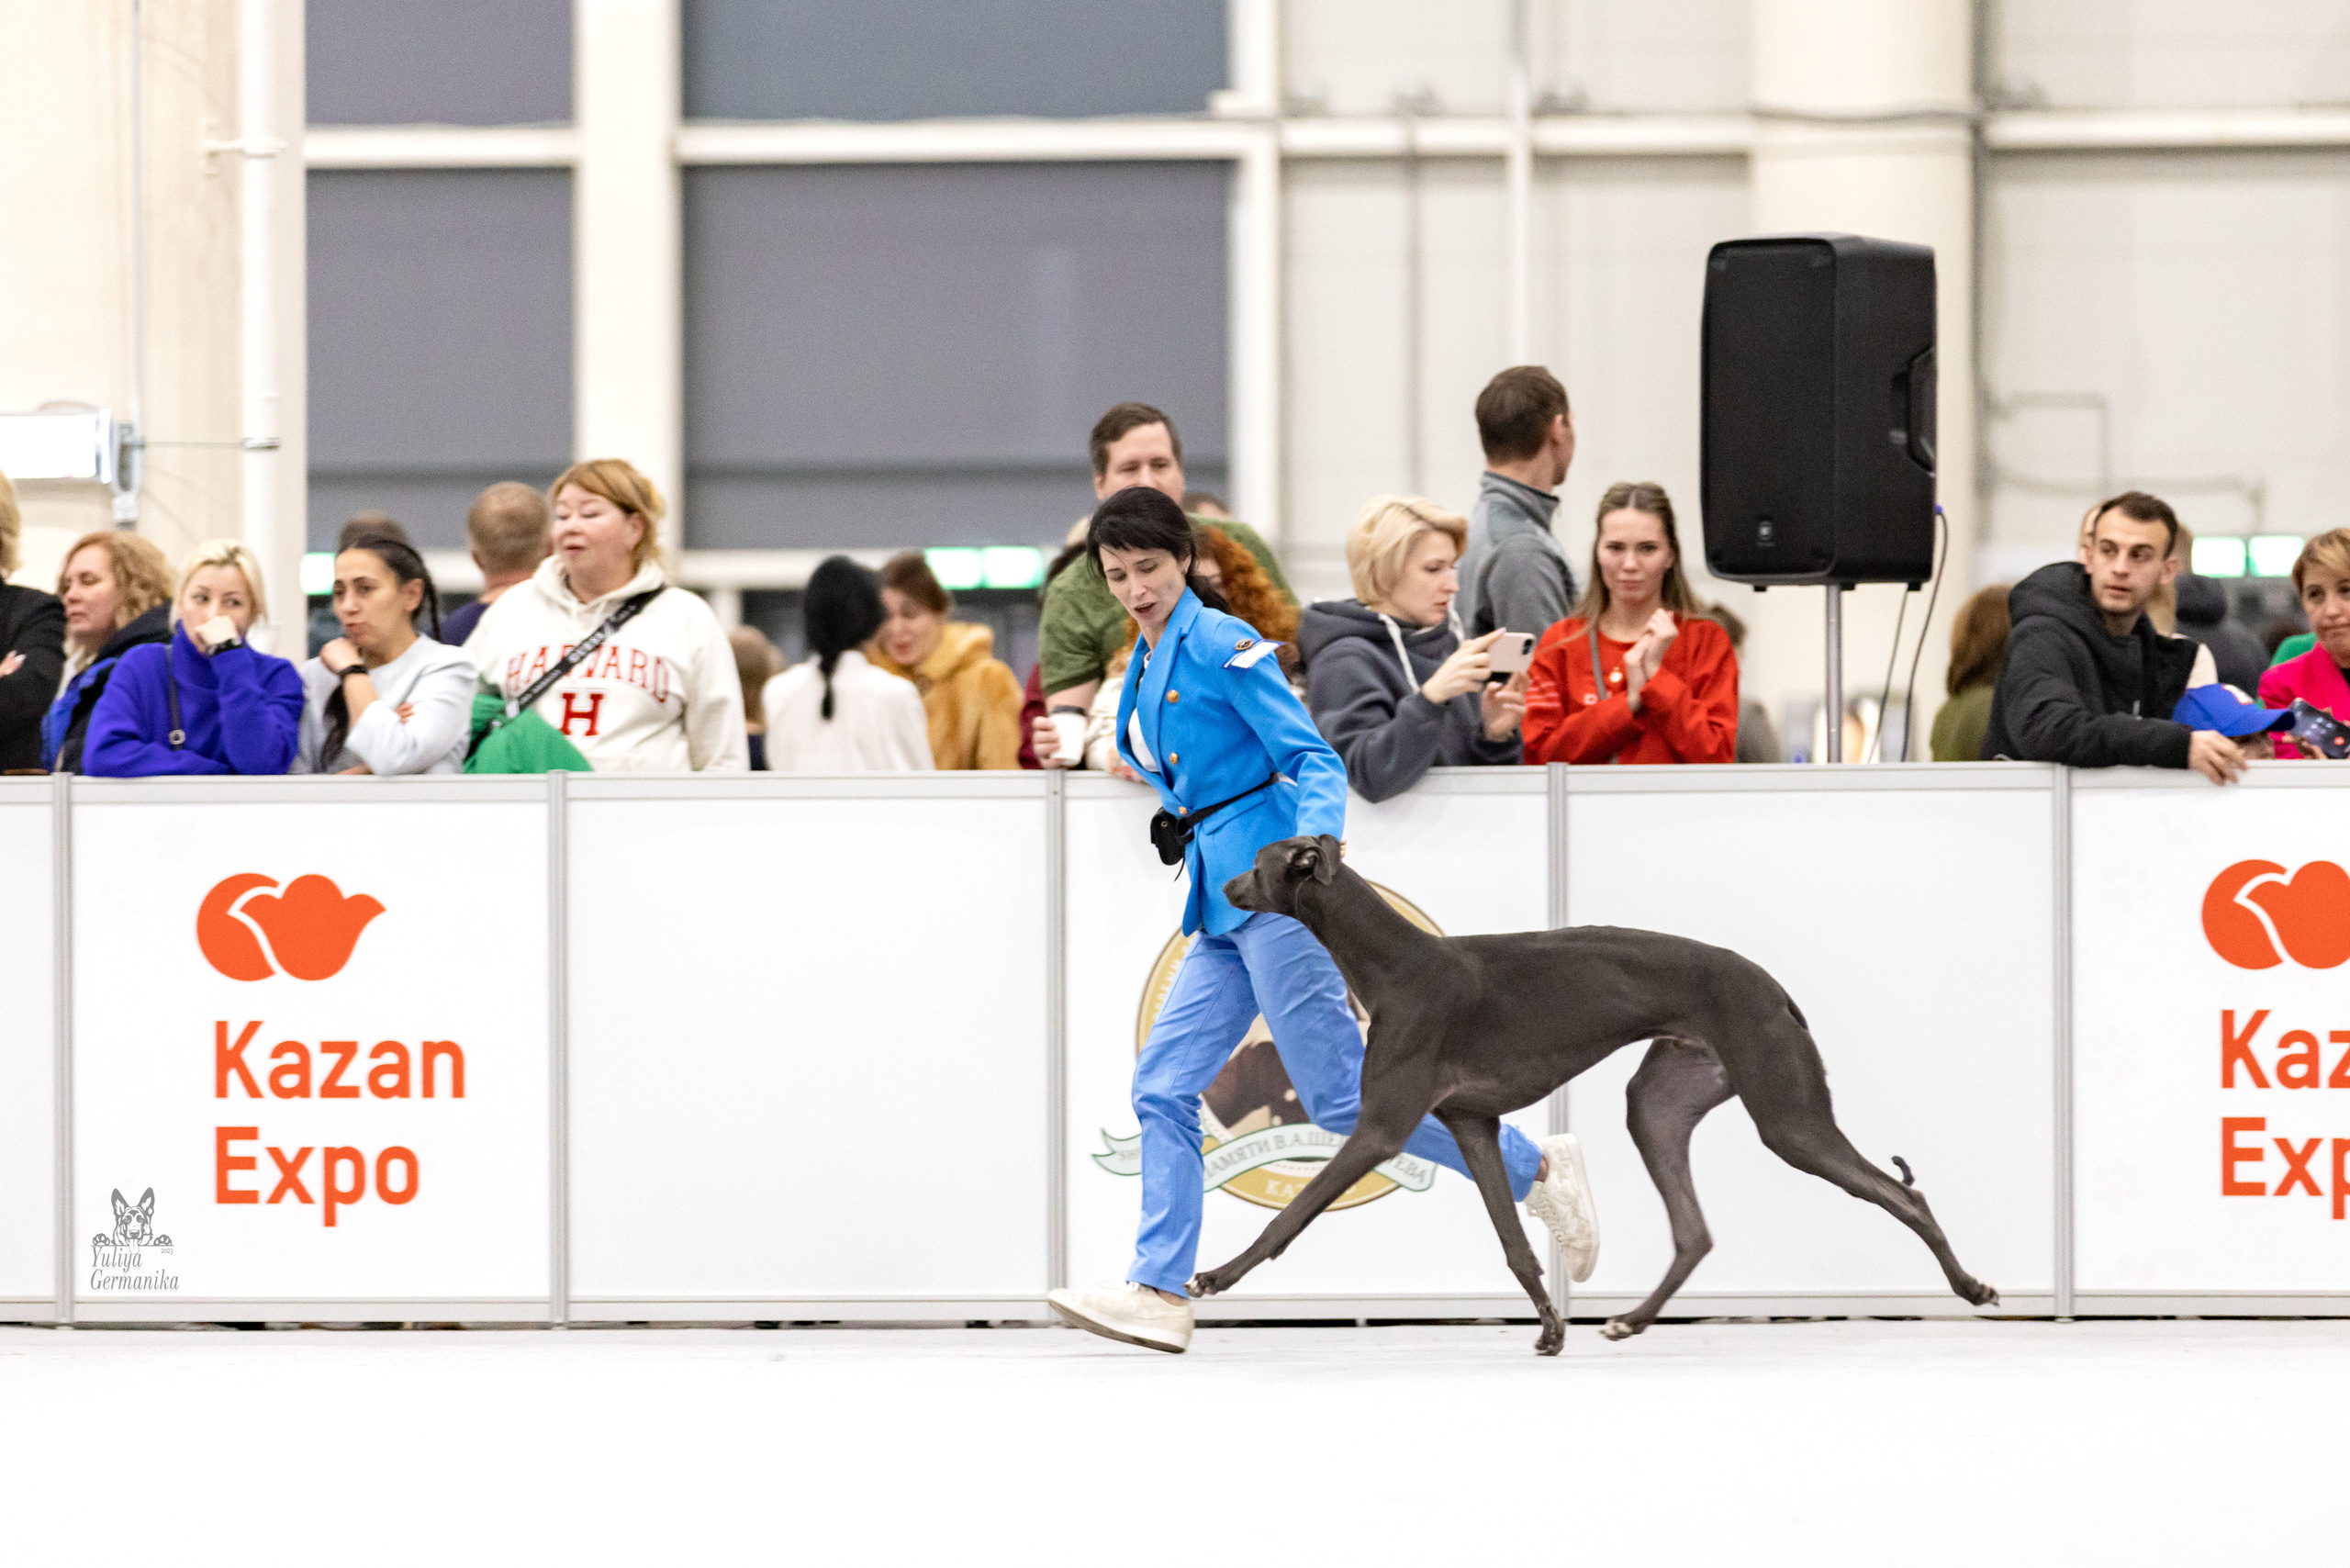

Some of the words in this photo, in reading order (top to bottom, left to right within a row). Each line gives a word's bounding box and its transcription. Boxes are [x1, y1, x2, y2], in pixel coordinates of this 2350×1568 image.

[559, 692, 604, 736] H
[214, 1020, 466, 1099] Kazan
[215, 1126, 420, 1227] Expo
[1204, 1138, 1271, 1181] АМЯТИ
